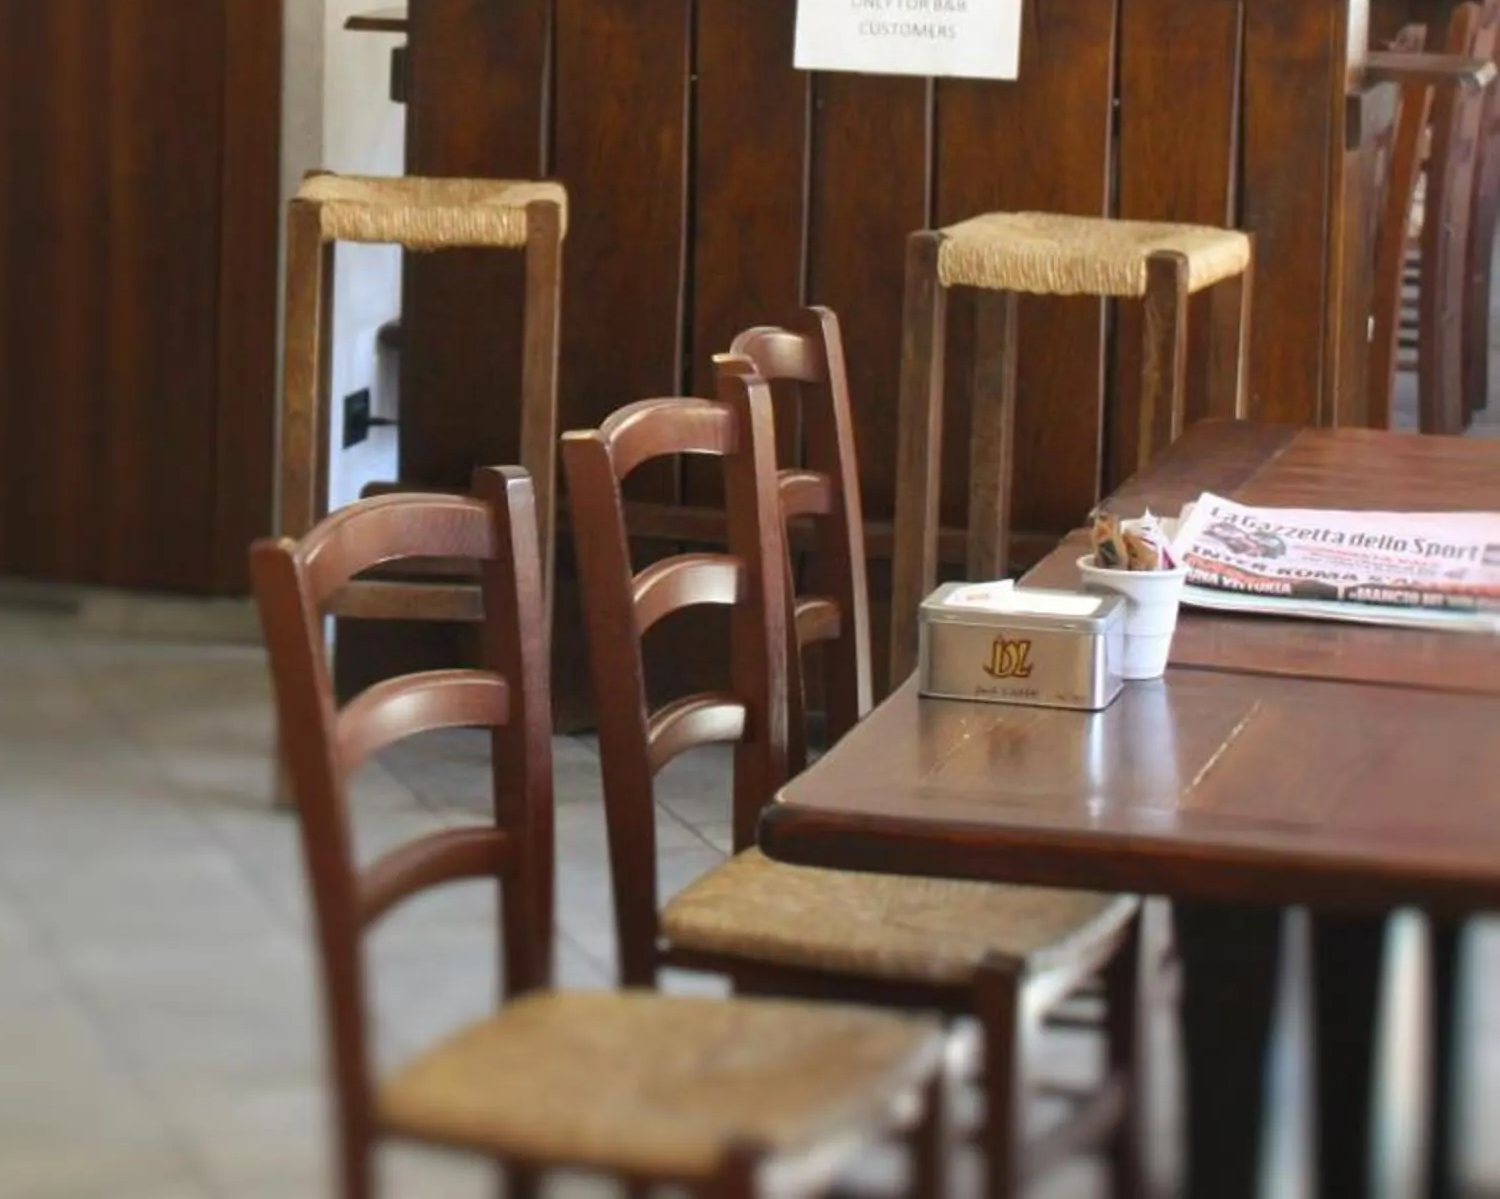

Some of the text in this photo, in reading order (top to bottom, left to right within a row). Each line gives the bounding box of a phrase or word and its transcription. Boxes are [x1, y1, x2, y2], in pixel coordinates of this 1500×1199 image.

[859, 21, 958, 40] CUSTOMERS
[1209, 507, 1239, 524] La
[1240, 514, 1347, 546] Gazzetta
[1348, 530, 1409, 552] dello
[1412, 538, 1480, 562] Sport
